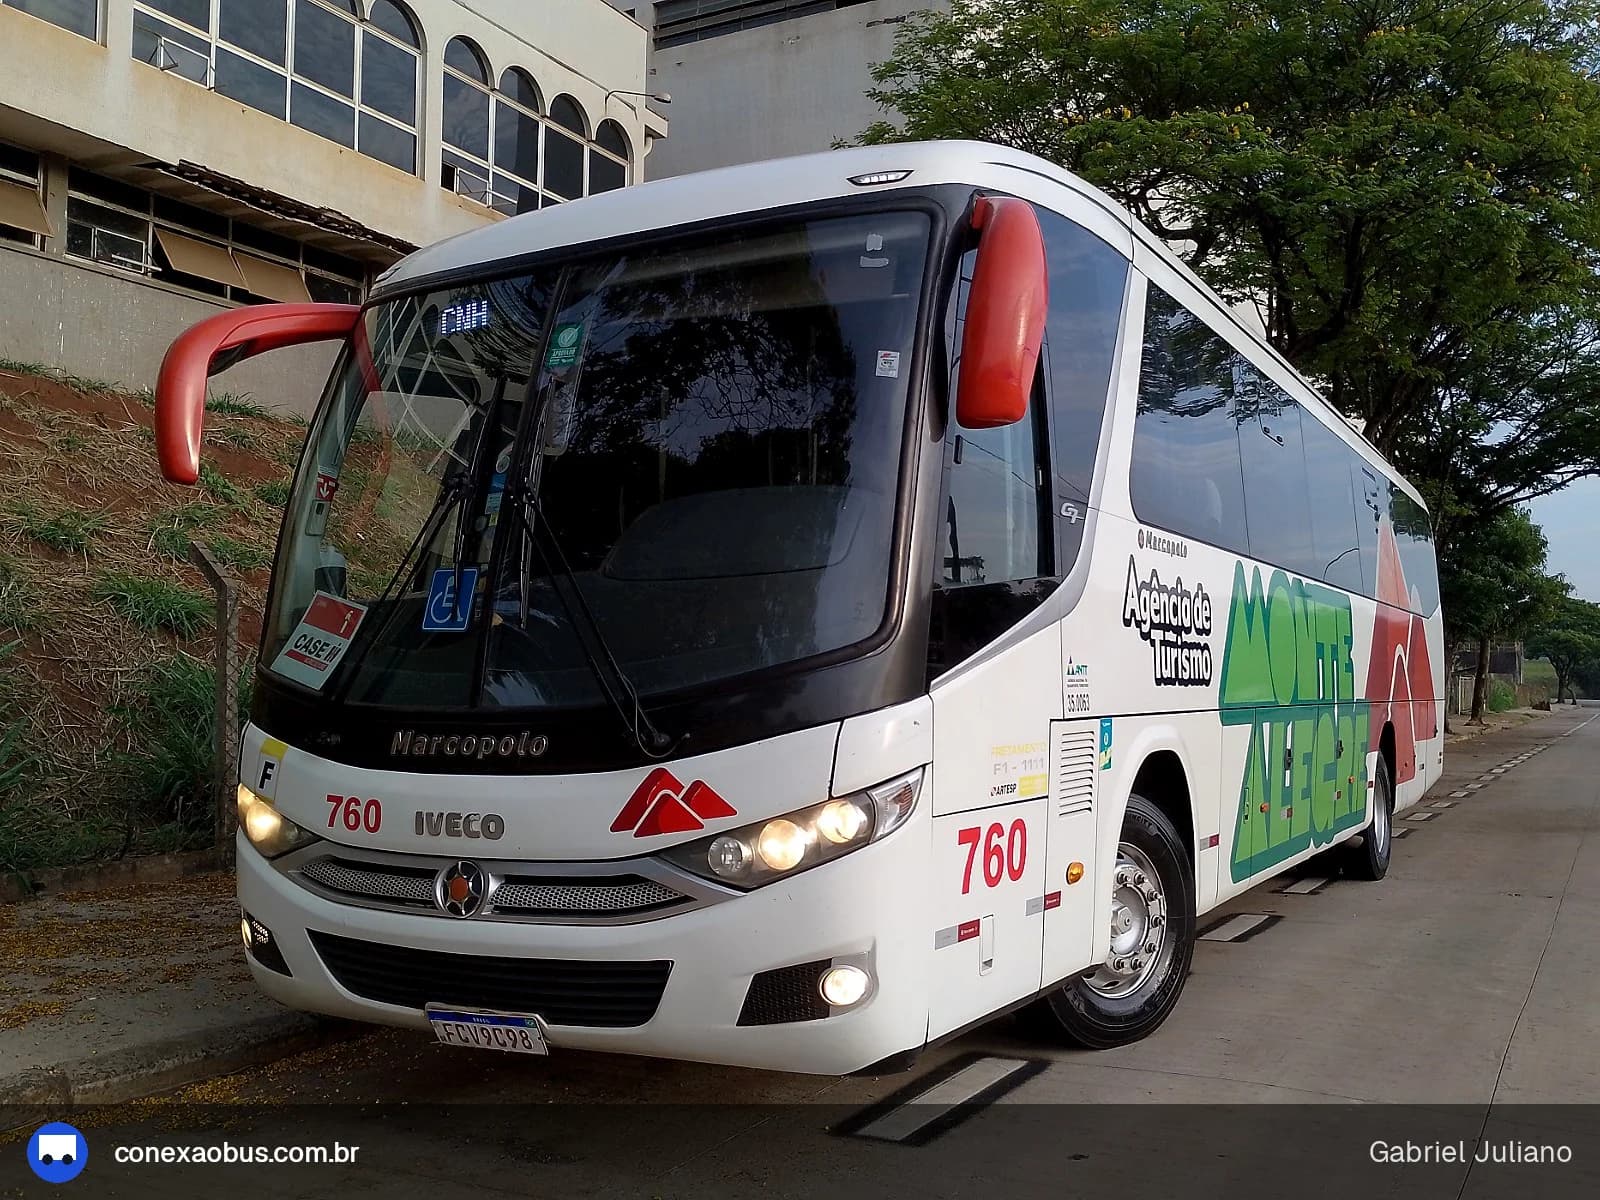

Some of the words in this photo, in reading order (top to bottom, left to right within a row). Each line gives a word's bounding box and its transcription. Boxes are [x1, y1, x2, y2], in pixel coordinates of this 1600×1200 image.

[441, 301, 487, 334] CNH
[1145, 530, 1188, 558] Marcopolo
[1123, 556, 1192, 639] Agência
[1193, 584, 1212, 635] de
[294, 633, 331, 659] CASE
[1221, 563, 1355, 706] MONTE
[1150, 629, 1212, 685] Turismo
[390, 729, 549, 759] Marcopolo
[258, 761, 276, 789] F
[1231, 708, 1369, 872] ALEGRE
[326, 795, 382, 833] 760
[414, 811, 505, 840] IVECO
[957, 818, 1027, 895] 760
[441, 1022, 534, 1050] FCV9C98
